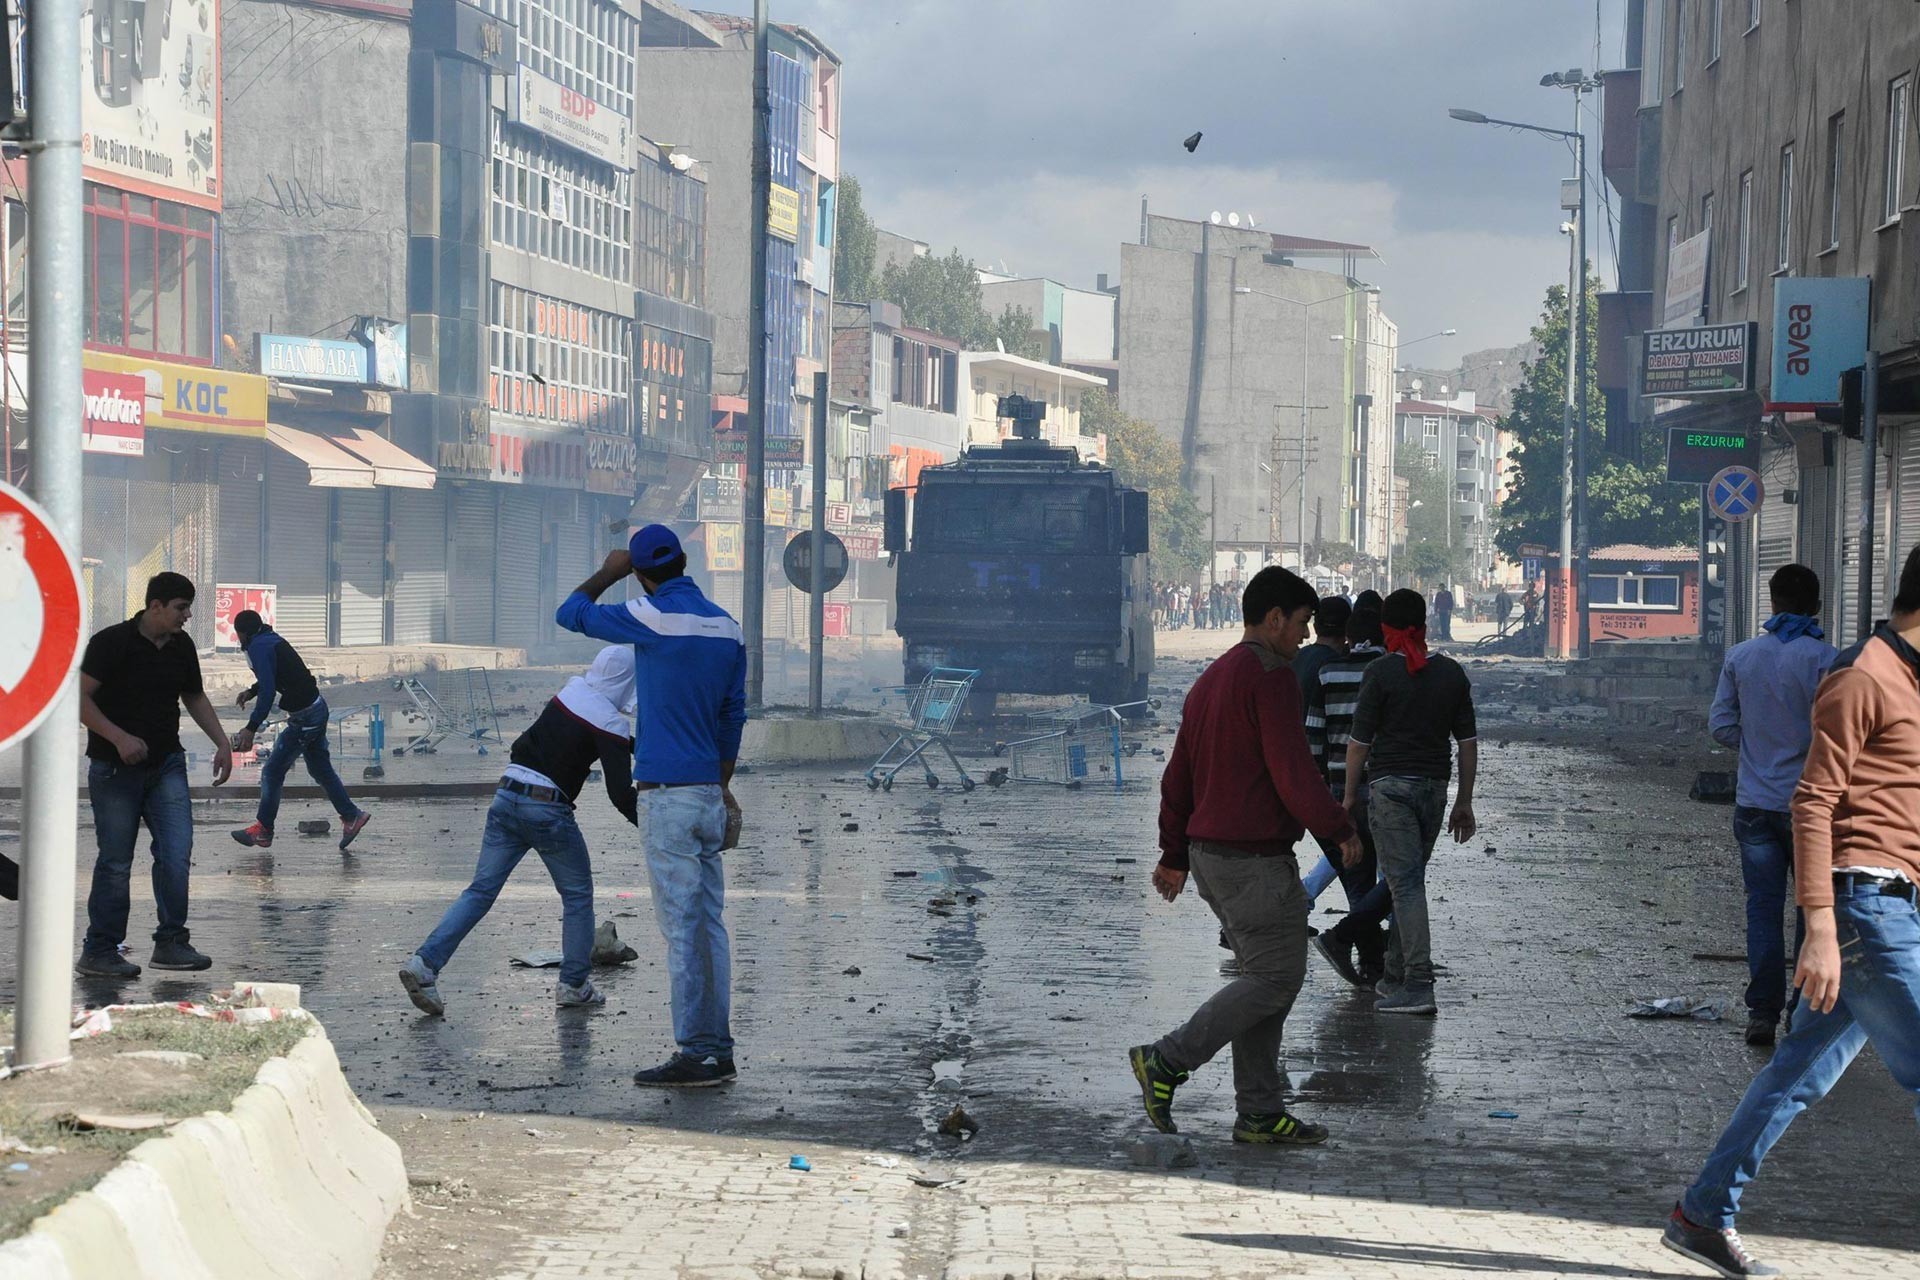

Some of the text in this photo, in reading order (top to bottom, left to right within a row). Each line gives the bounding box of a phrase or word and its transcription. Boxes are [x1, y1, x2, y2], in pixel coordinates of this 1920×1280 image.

[561, 86, 596, 121] BDP
[94, 135, 173, 178] Koç Büro Ofis Mobilya
[538, 299, 588, 346] DORUK
[1649, 328, 1743, 352] ERZURUM
[1787, 304, 1812, 376] avea
[643, 338, 684, 378] DORUK
[1692, 346, 1744, 367] YAZIHANESİ
[85, 387, 141, 425] vodafone
[589, 438, 637, 473] eczane
[1687, 434, 1745, 449] ERZURUM
[834, 507, 846, 521] E
[848, 548, 876, 560] ANESİ
[968, 561, 1040, 589] T-1
[1614, 621, 1626, 629] 312
